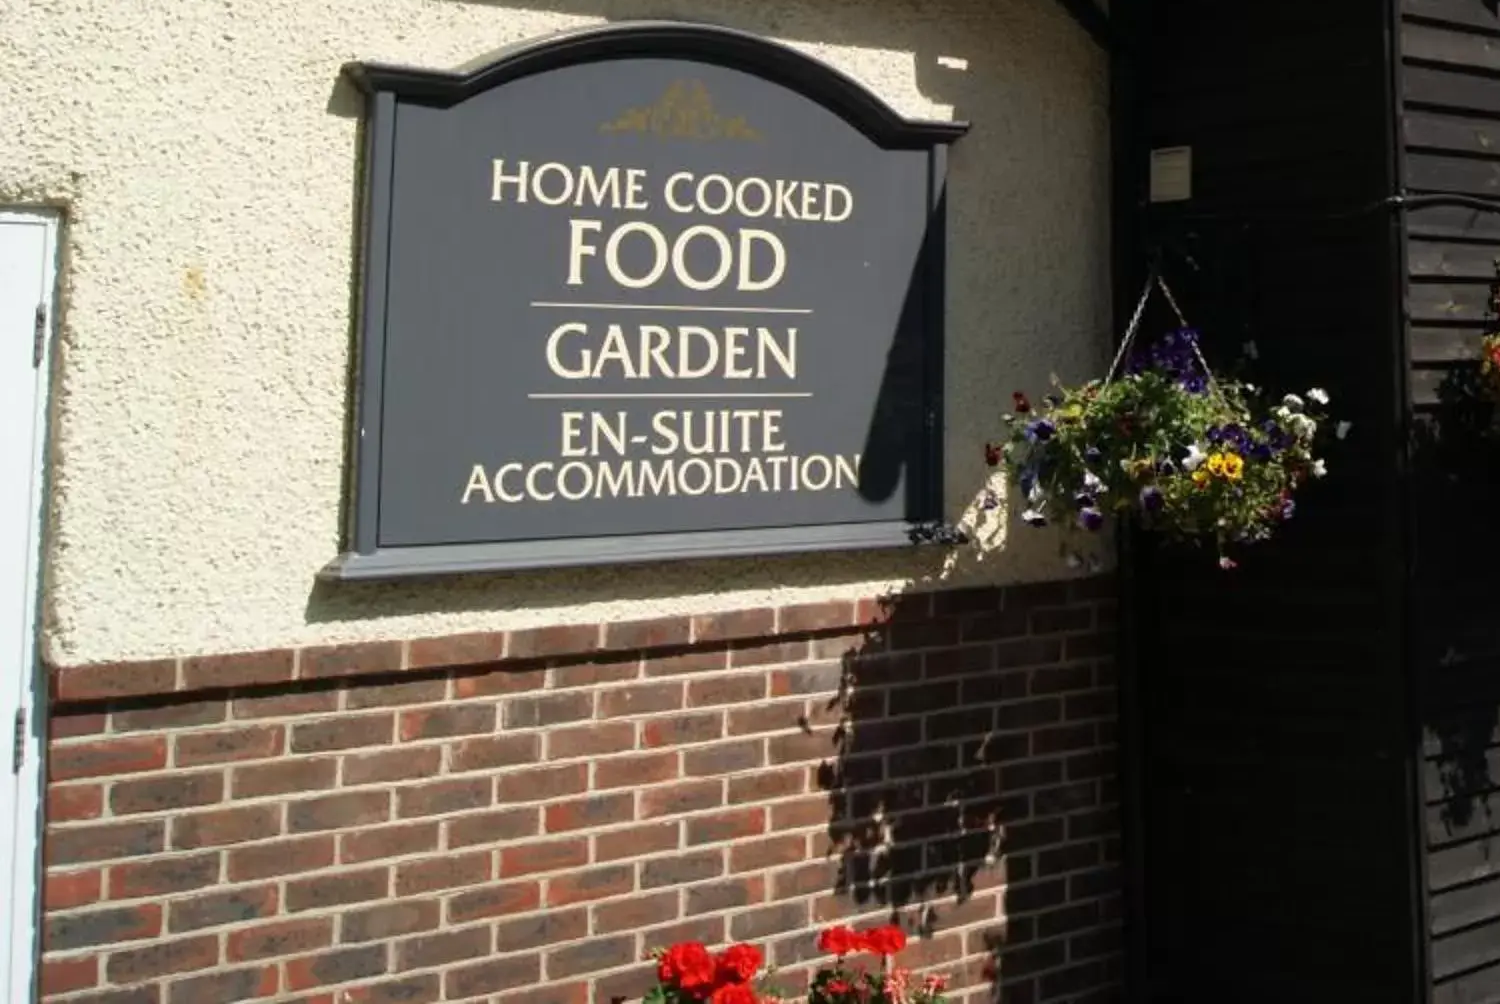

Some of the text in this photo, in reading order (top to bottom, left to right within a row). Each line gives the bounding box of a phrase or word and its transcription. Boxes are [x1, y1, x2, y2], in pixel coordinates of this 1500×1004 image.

[491, 158, 853, 222] HOME COOKED
[566, 218, 787, 292] FOOD
[545, 322, 798, 380] GARDEN
[560, 409, 786, 458] EN-SUITE
[460, 453, 861, 505] ACCOMMODATION
